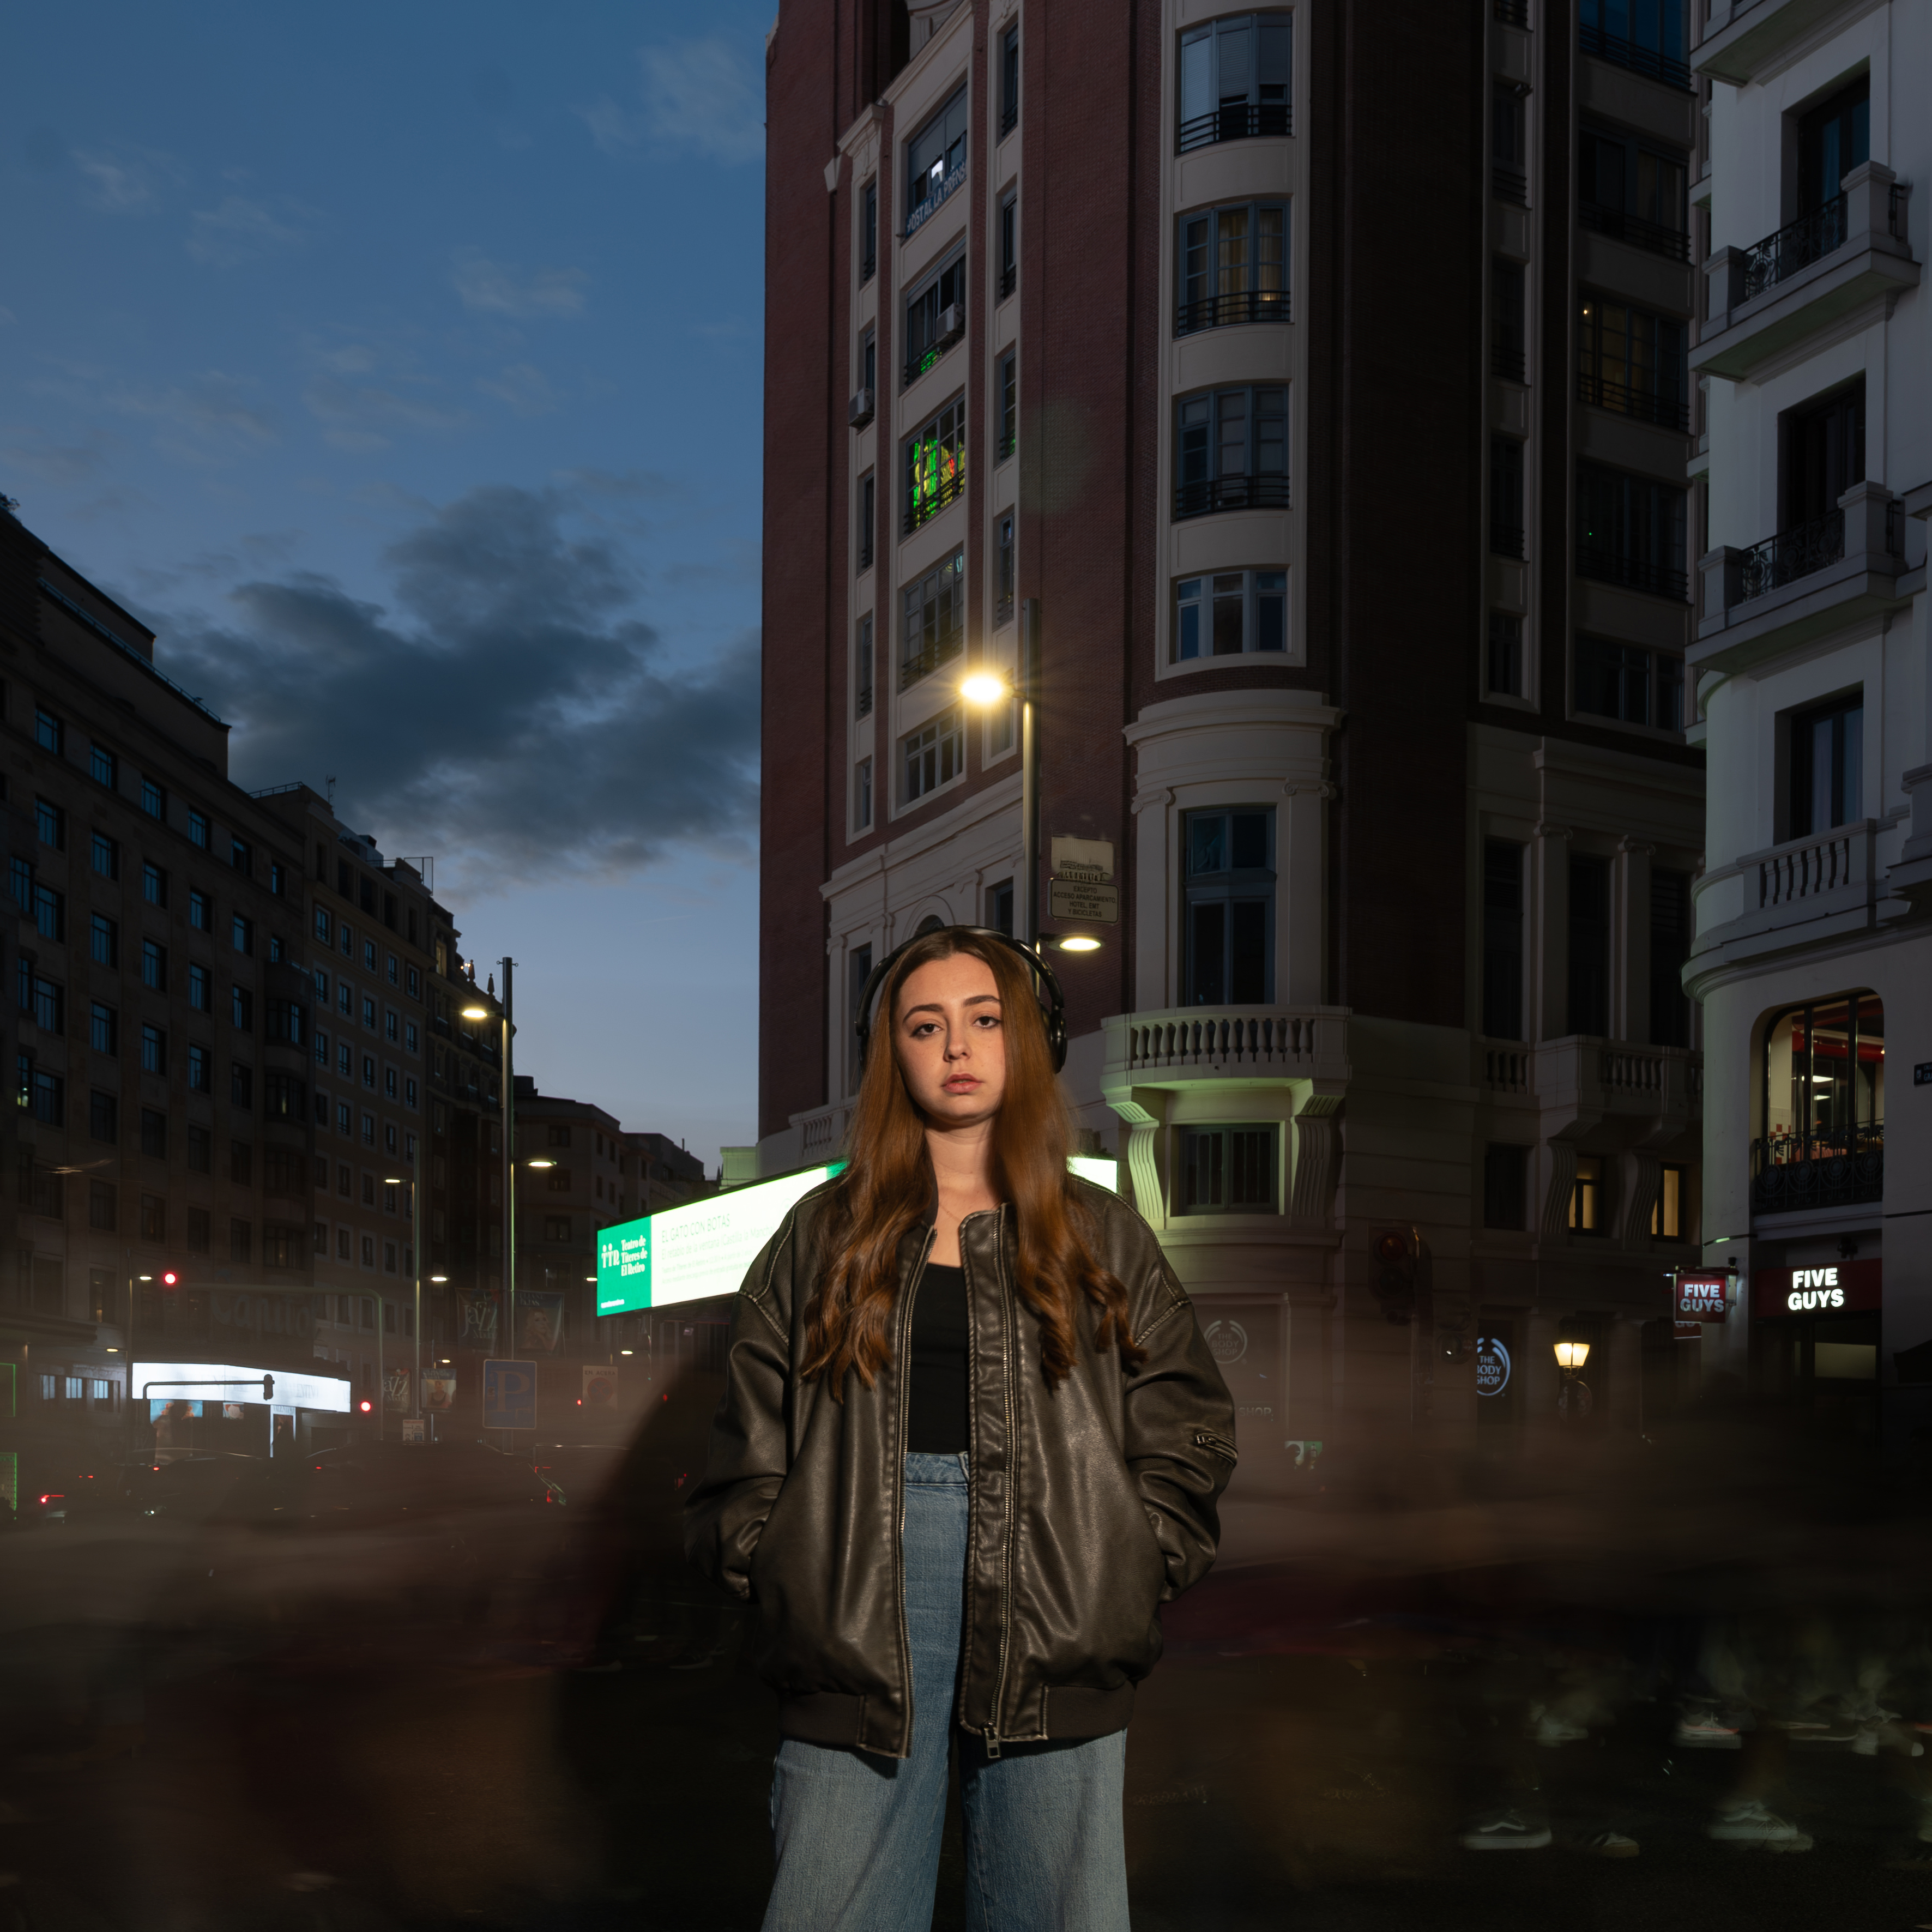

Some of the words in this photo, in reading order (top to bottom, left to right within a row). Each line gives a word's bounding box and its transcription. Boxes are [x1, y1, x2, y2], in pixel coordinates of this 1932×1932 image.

[934, 188, 943, 208] LA
[1073, 886, 1097, 894] EXCEPTO
[1072, 909, 1102, 917] BICICLETAS
[662, 1230, 668, 1243] EL
[671, 1224, 689, 1241] GATO
[690, 1221, 705, 1236] CON
[707, 1213, 730, 1231] BOTAS
[621, 1239, 639, 1251] Teatro
[639, 1235, 647, 1247] de
[662, 1248, 666, 1260] El
[667, 1245, 685, 1259] retablo
[686, 1243, 692, 1254] de
[693, 1241, 698, 1252] la
[699, 1239, 720, 1251] ventana
[744, 1229, 748, 1241] la
[640, 1247, 648, 1259] de
[621, 1264, 627, 1276] El
[627, 1261, 645, 1275] Retiro
[1793, 1267, 1838, 1289] FIVE
[1685, 1284, 1720, 1298] FIVE
[1680, 1298, 1724, 1313] GUYS
[1788, 1288, 1844, 1311] GUYS
[1211, 1340, 1239, 1348] BODY
[1479, 1355, 1495, 1365] THE
[490, 1370, 530, 1412] P
